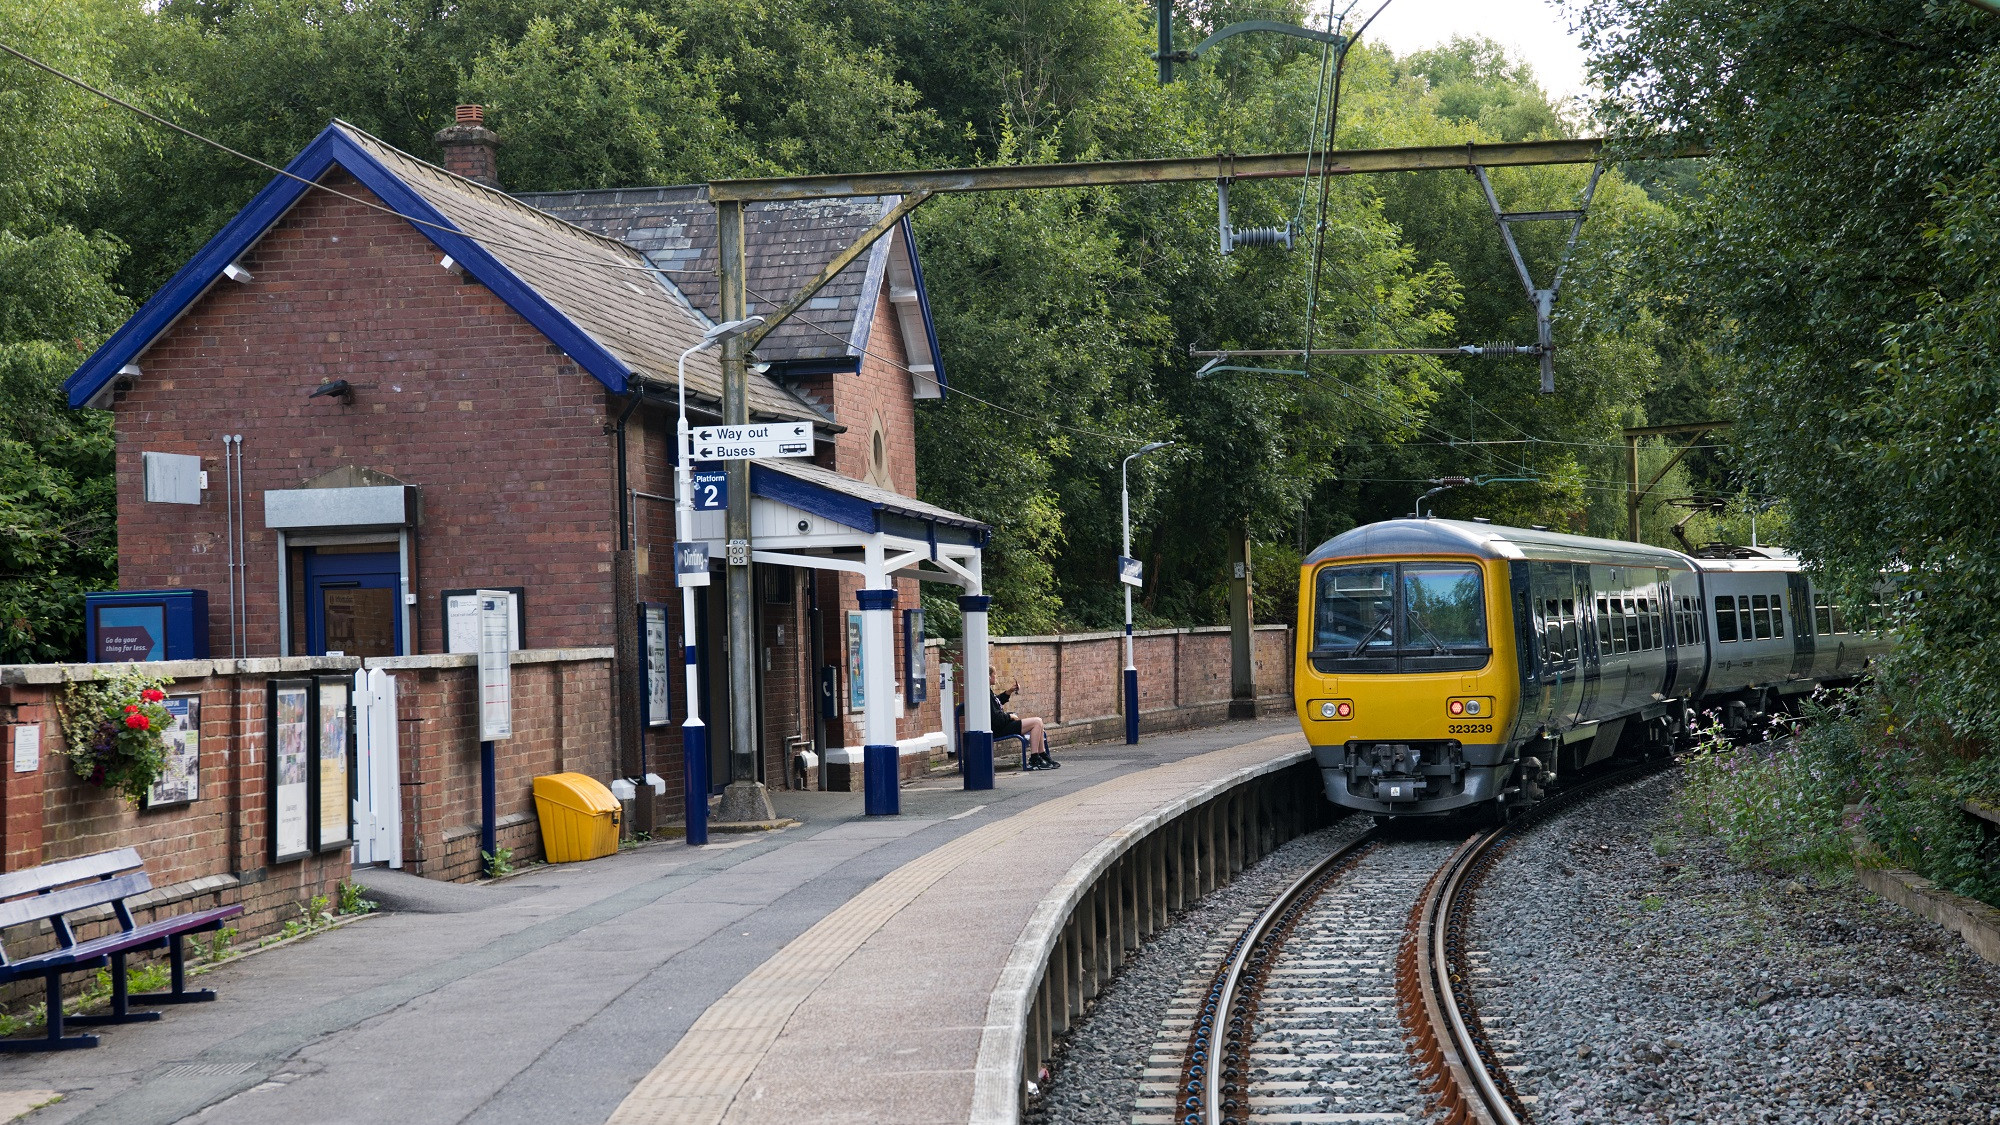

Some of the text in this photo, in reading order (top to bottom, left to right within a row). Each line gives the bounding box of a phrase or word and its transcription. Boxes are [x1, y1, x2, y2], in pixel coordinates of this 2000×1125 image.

[717, 427, 768, 440] Way out
[717, 446, 755, 457] Buses
[704, 485, 719, 507] 2
[684, 549, 704, 570] Dinting
[105, 645, 122, 653] thing
[122, 645, 132, 653] for
[1448, 724, 1493, 733] 323239
